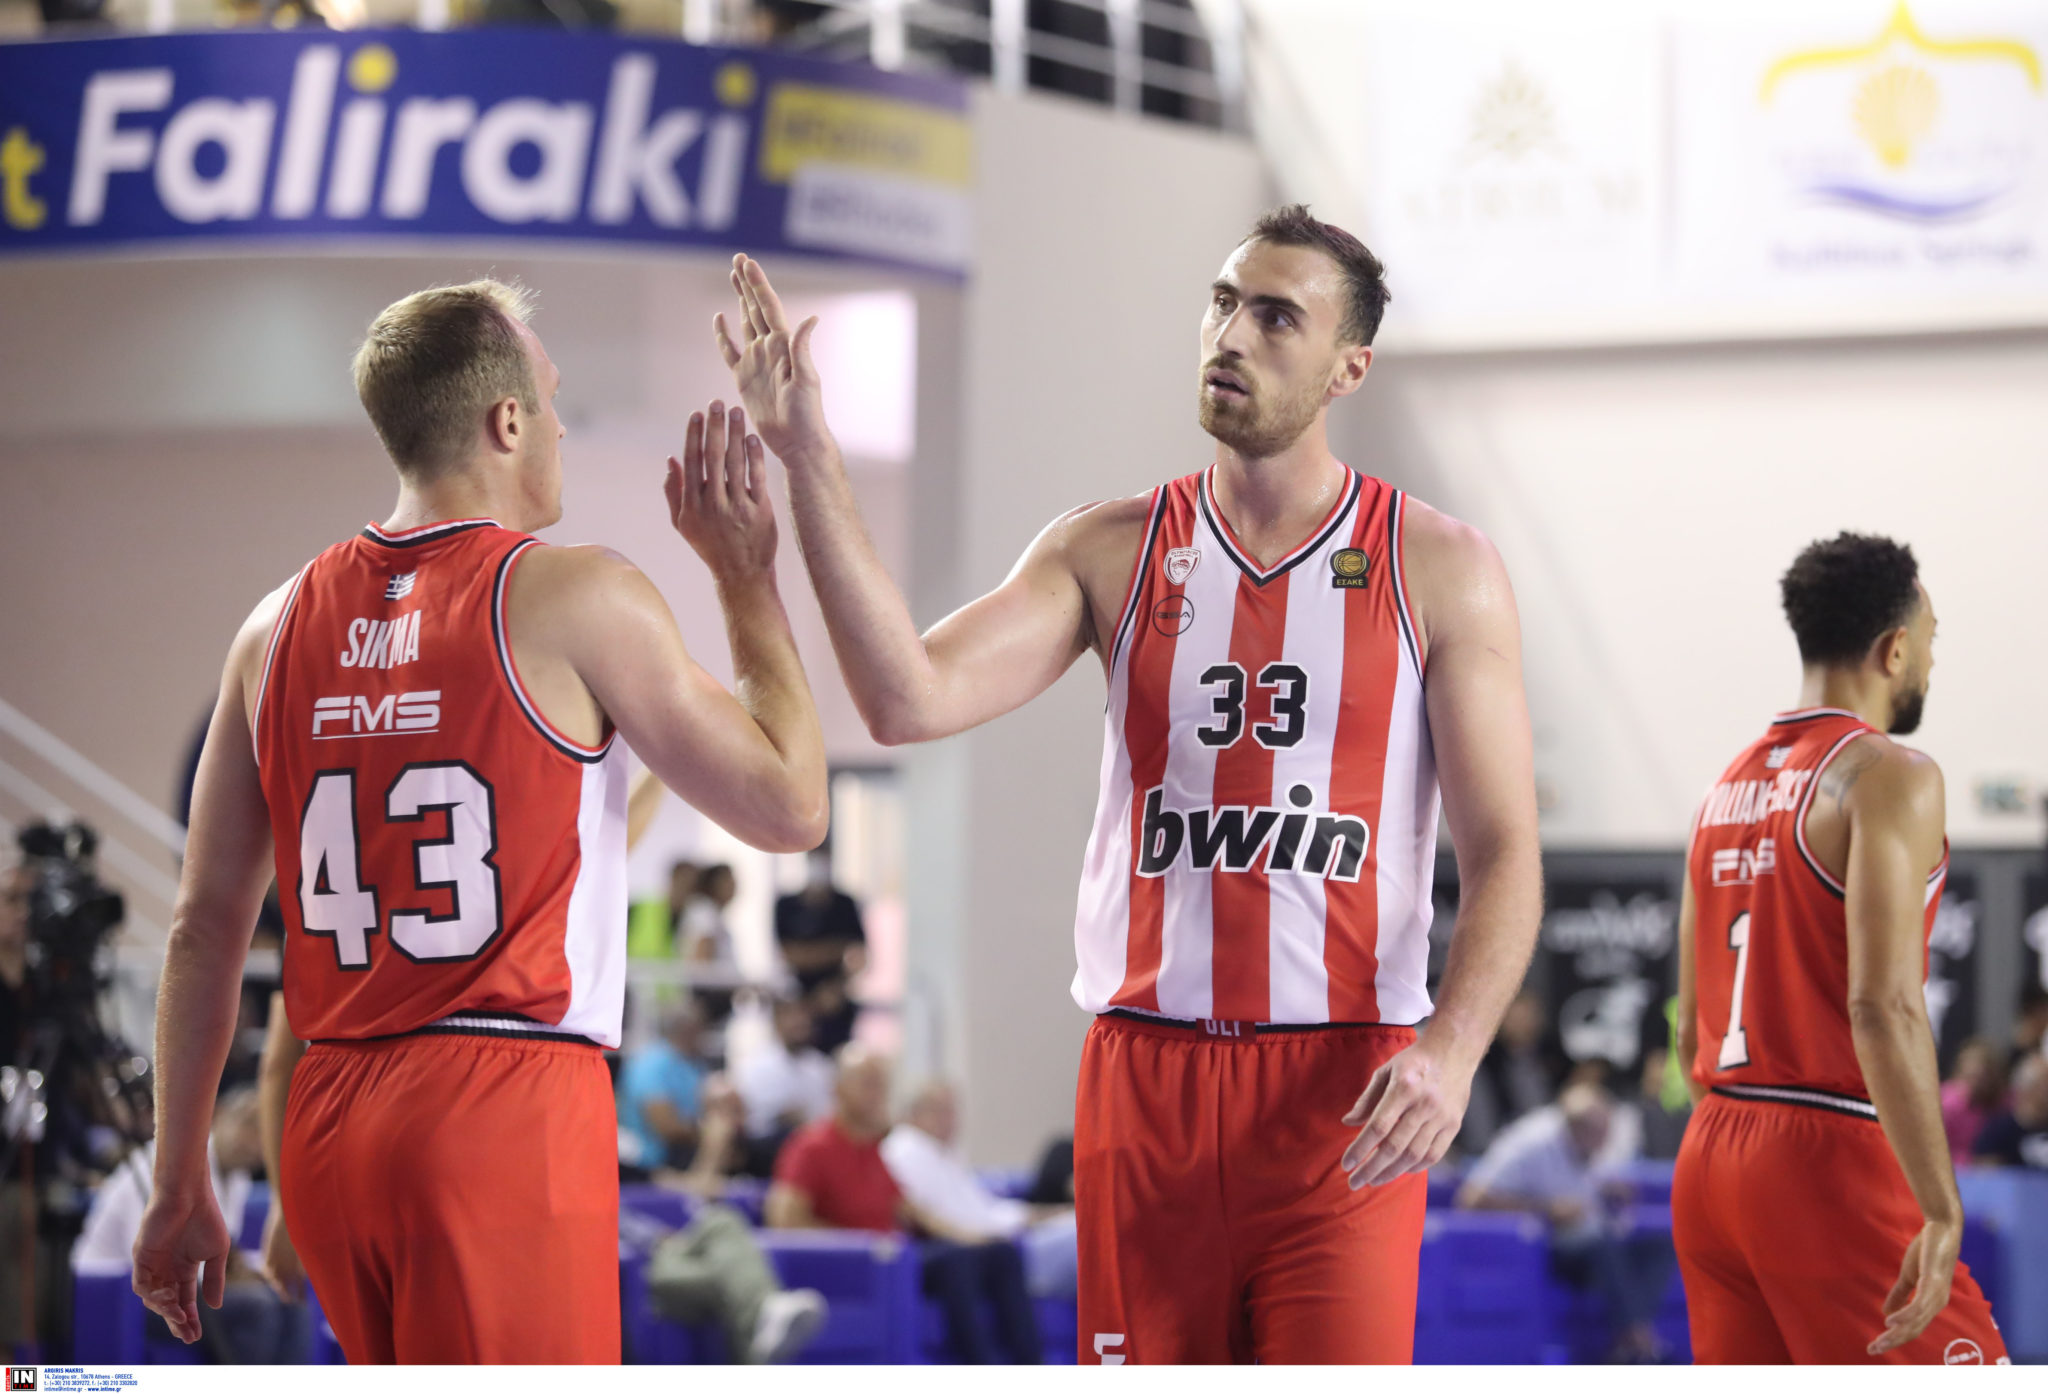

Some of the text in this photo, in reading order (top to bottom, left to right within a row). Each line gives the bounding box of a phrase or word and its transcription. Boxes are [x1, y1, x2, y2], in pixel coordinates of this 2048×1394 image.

[67, 44, 755, 230] Faliraki
[340, 609, 421, 669] SIKMA
[312, 690, 441, 734] FMS
[1197, 661, 1308, 750] 33
[297, 759, 505, 972] 43
[1136, 783, 1369, 882] bwin
[1717, 910, 1751, 1071] 1
